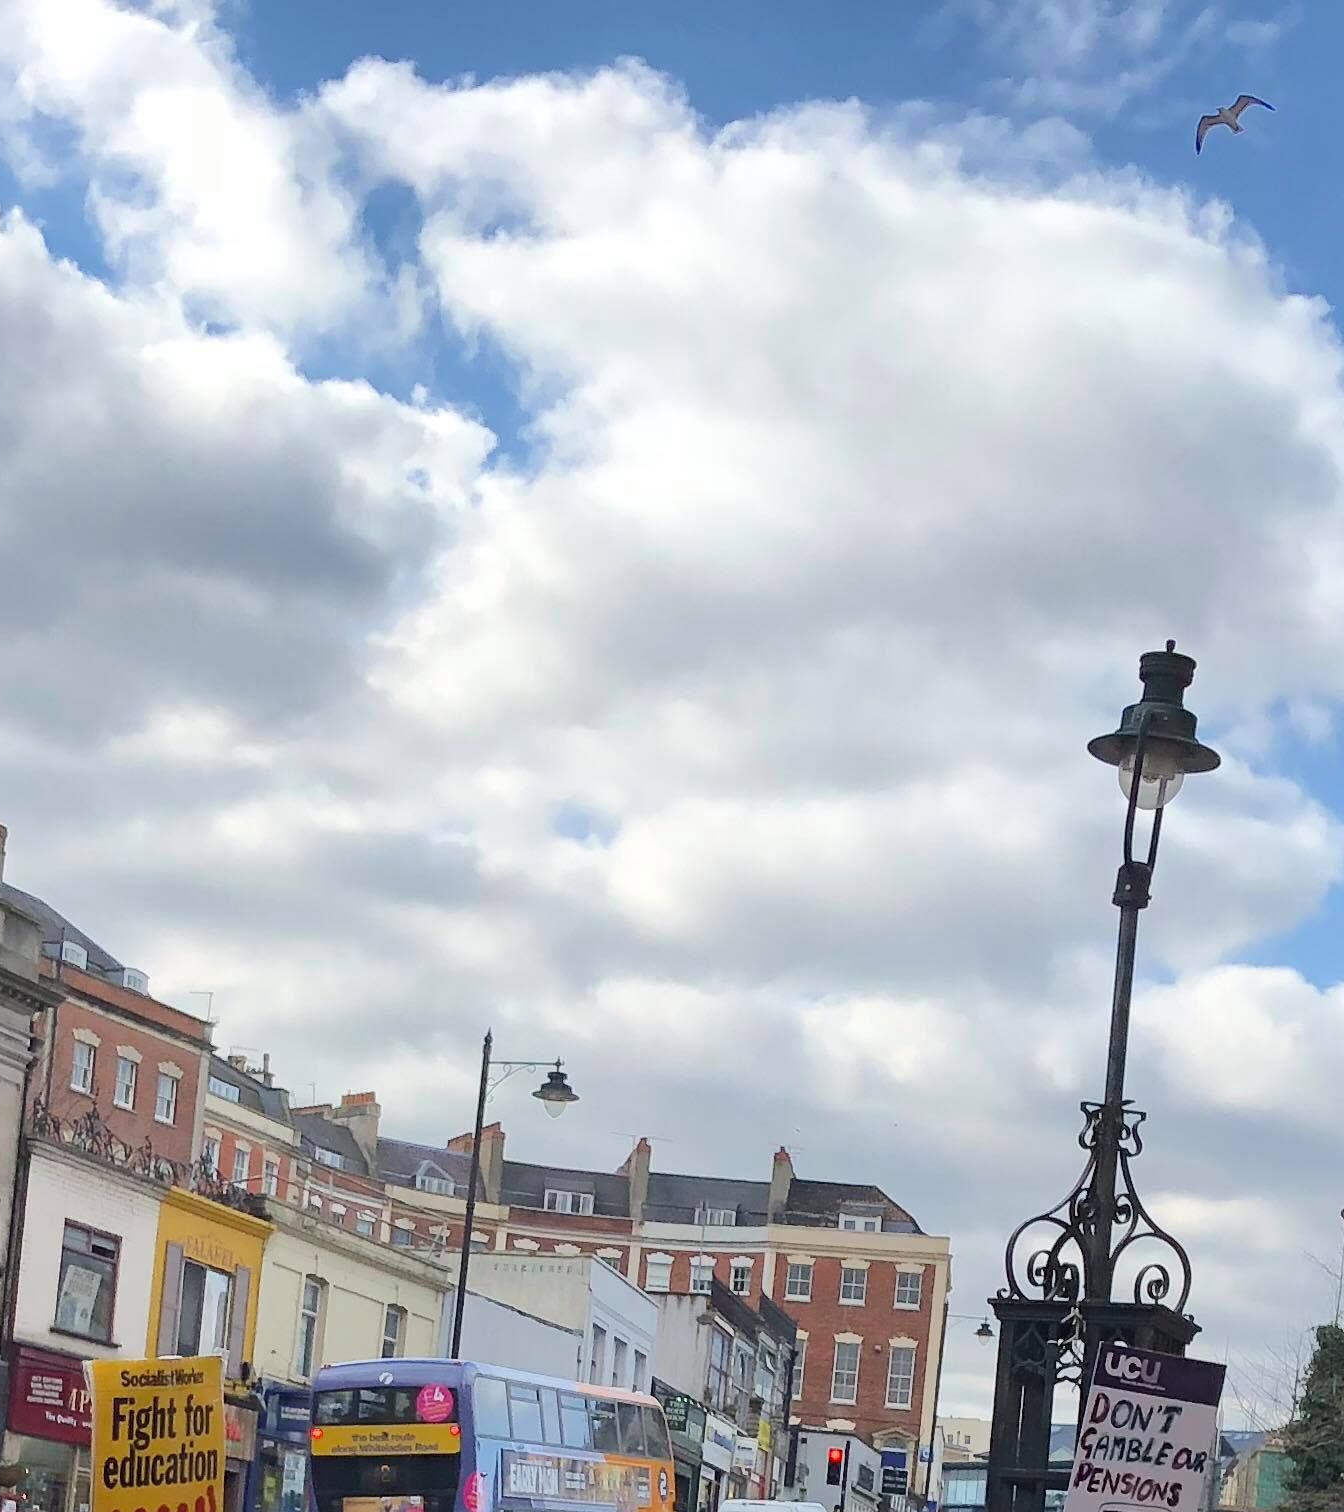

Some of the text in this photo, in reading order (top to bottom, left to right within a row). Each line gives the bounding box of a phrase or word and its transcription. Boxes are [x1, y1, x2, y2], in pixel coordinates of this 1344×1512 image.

[121, 1370, 174, 1387] Socialist
[112, 1396, 177, 1450] Fight
[185, 1394, 214, 1437] for
[1089, 1393, 1182, 1434] DON'T
[103, 1441, 218, 1489] education
[1080, 1427, 1173, 1466] GAMBLE
[1073, 1462, 1182, 1507] PENSIONS
